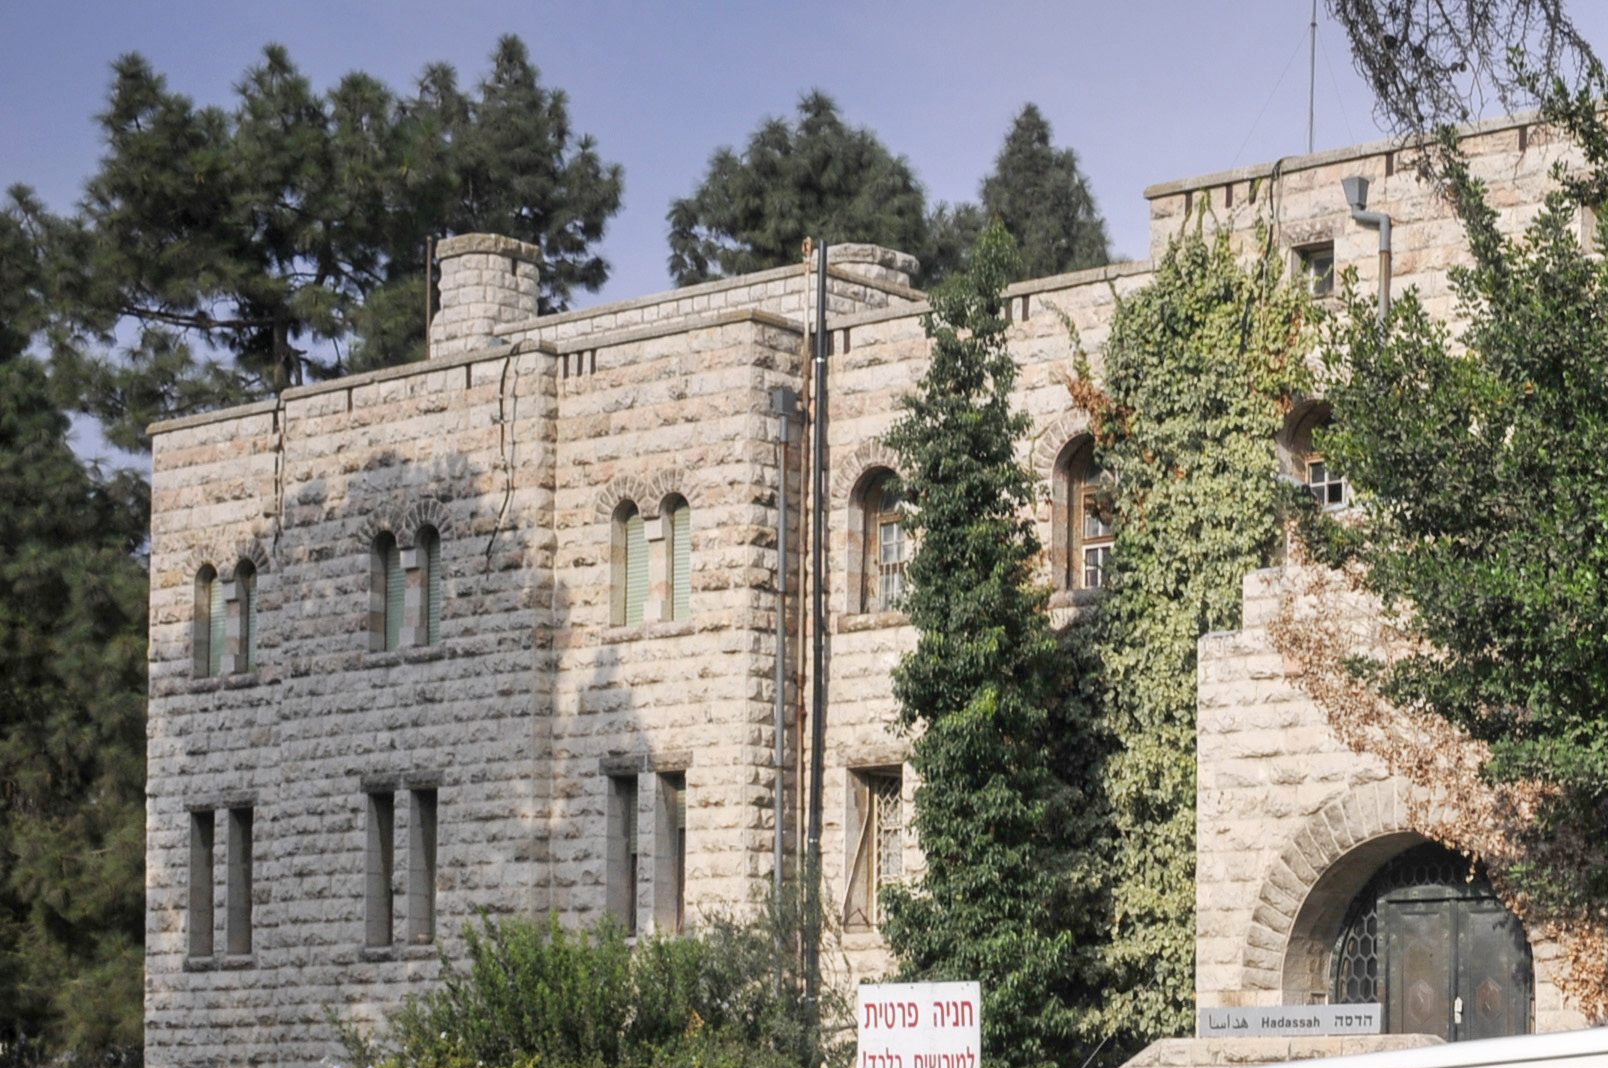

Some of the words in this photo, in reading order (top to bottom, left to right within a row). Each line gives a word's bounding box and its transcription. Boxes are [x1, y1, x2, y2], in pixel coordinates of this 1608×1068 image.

[864, 1001, 919, 1029] פרטית
[933, 1000, 974, 1028] חניה
[1261, 1015, 1321, 1030] Hadassah
[1334, 1014, 1373, 1028] הדסה
